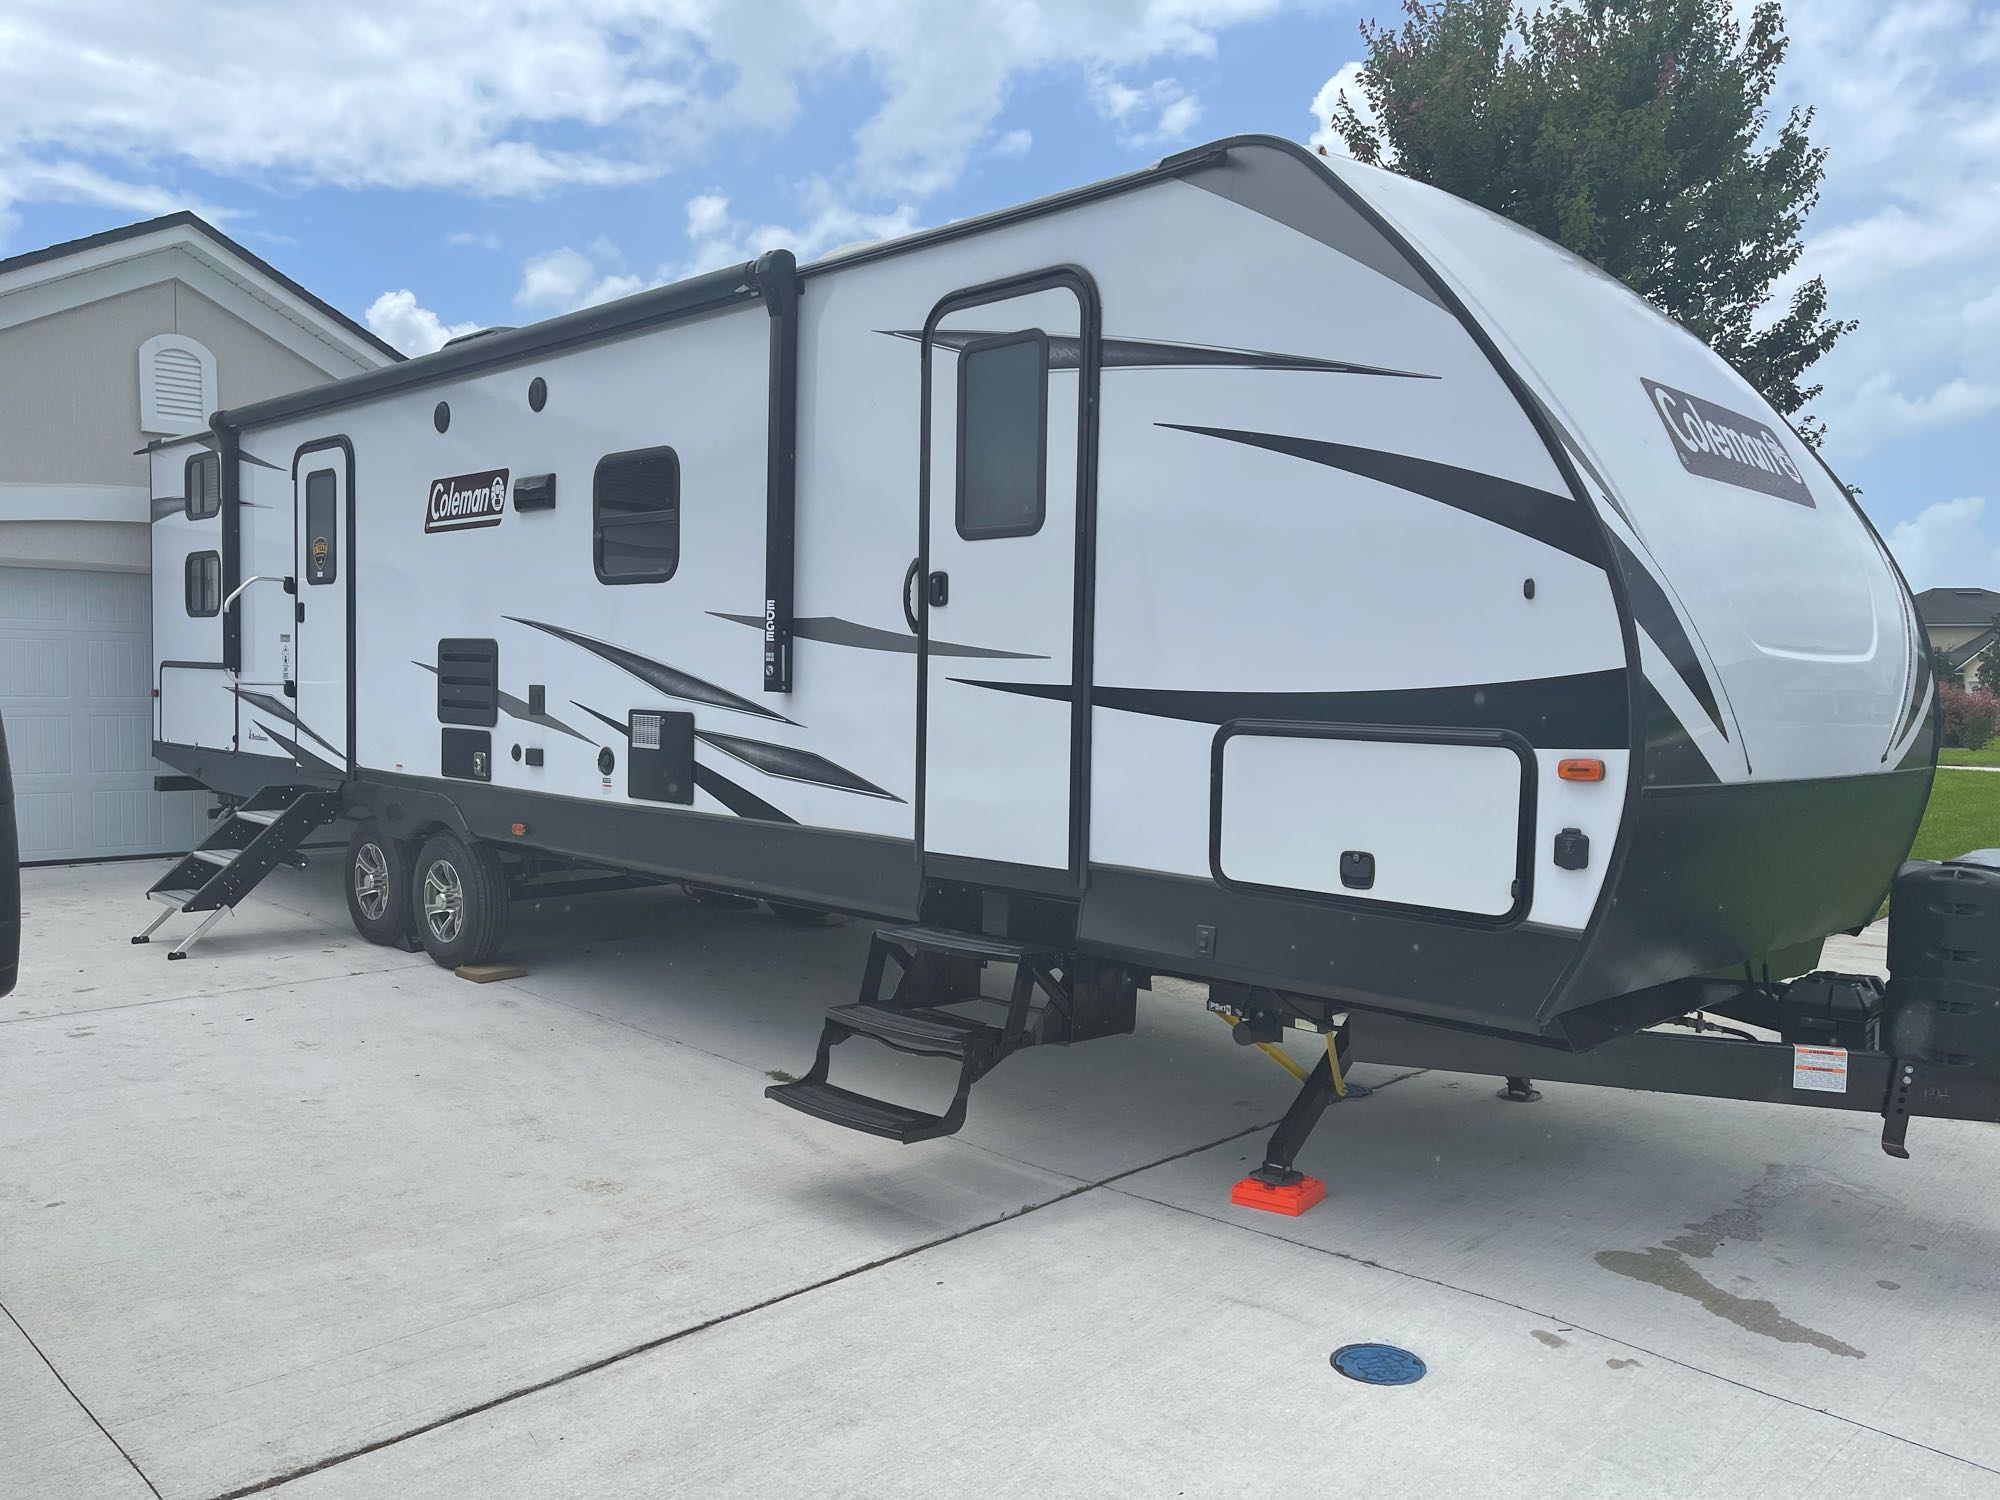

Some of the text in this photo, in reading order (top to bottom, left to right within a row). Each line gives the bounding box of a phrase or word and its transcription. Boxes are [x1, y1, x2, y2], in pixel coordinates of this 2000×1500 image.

[1655, 387, 1782, 475] Coleman
[431, 482, 490, 520] Coleman
[766, 600, 775, 641] EDGE
